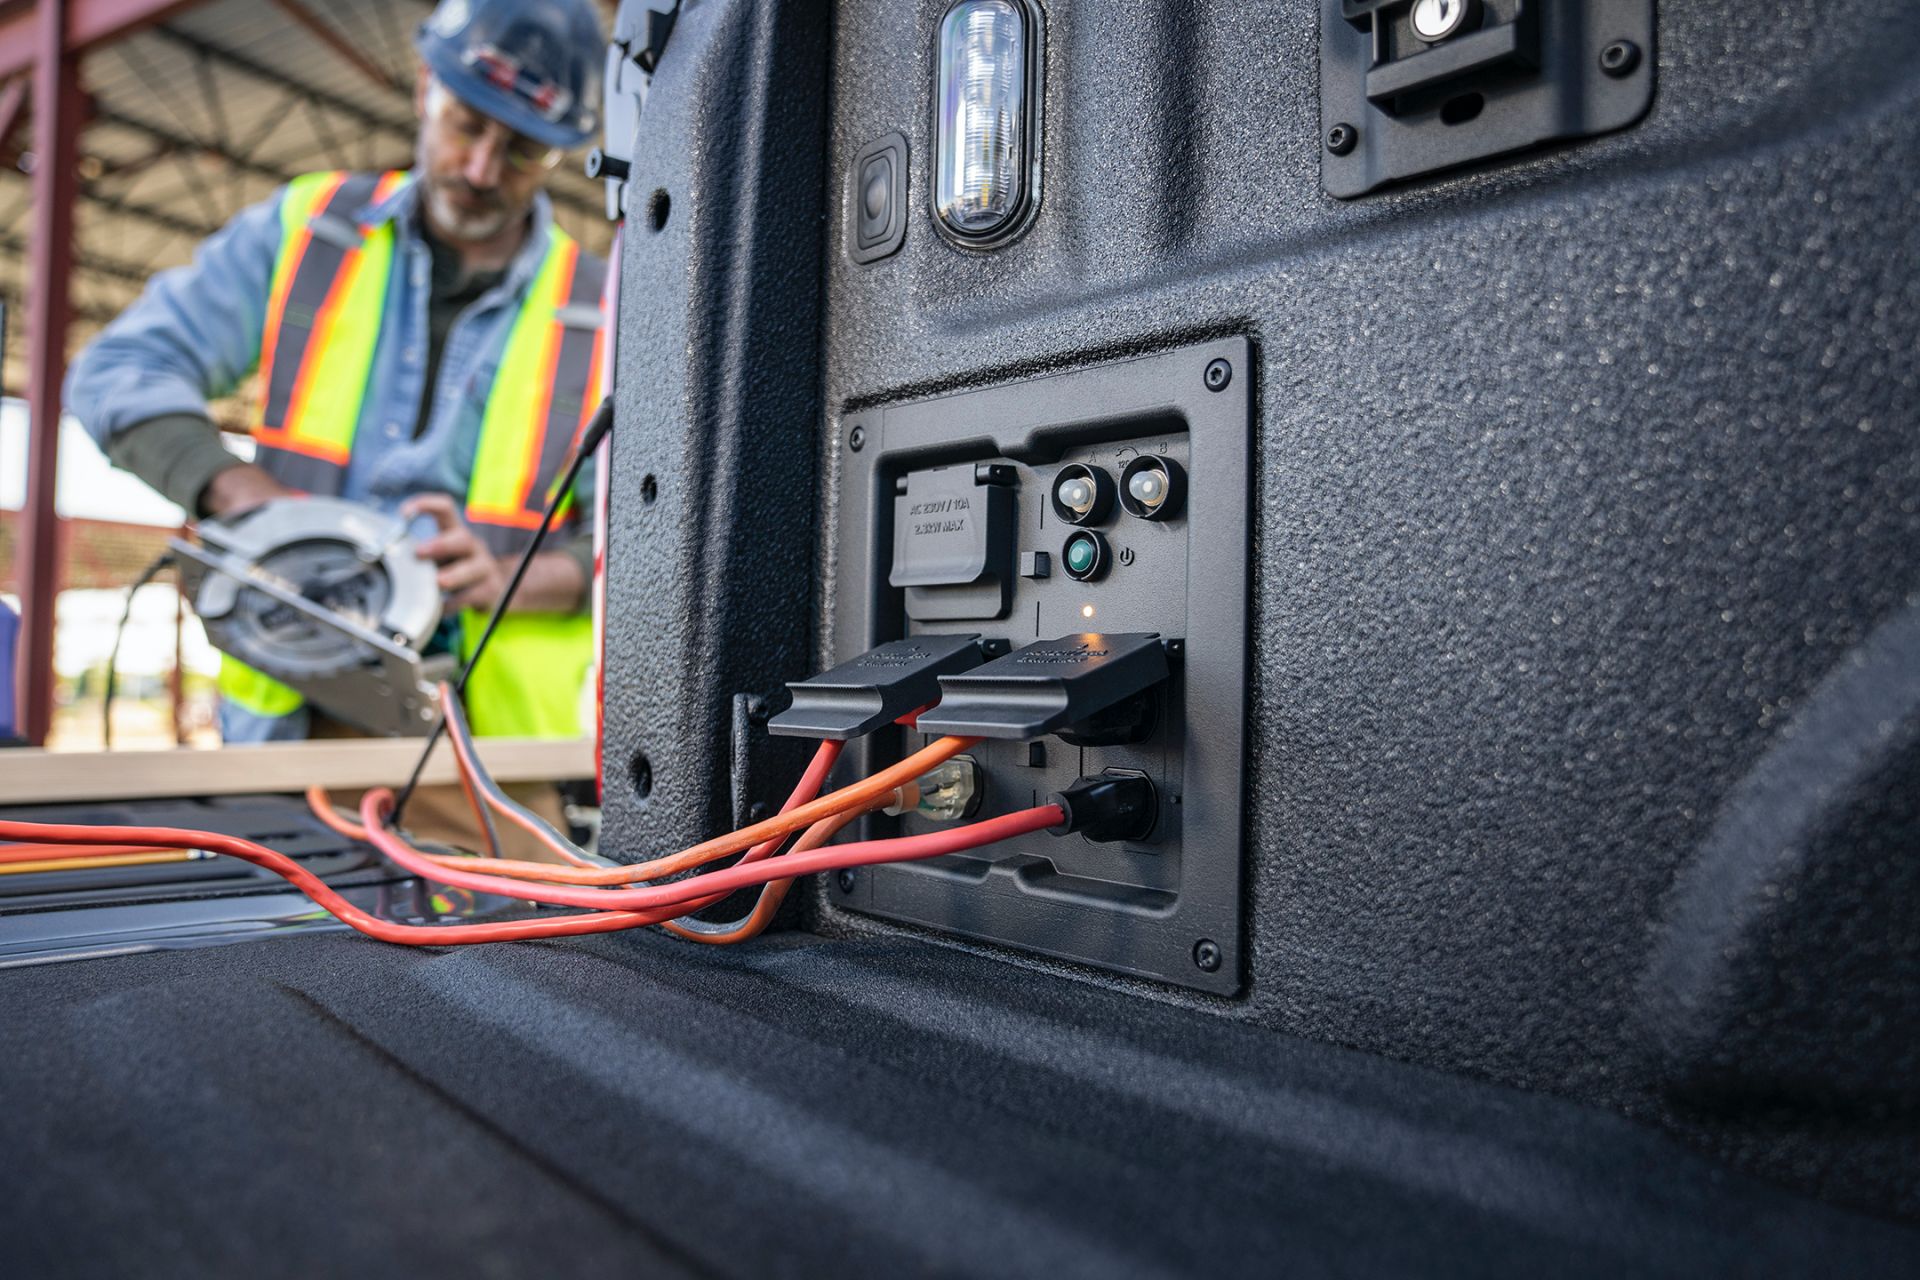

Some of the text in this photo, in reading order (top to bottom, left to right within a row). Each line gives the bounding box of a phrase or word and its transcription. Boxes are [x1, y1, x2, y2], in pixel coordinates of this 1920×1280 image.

[1159, 441, 1168, 454] B
[910, 504, 922, 516] AC
[953, 497, 970, 510] 10A
[942, 519, 964, 533] MAX
